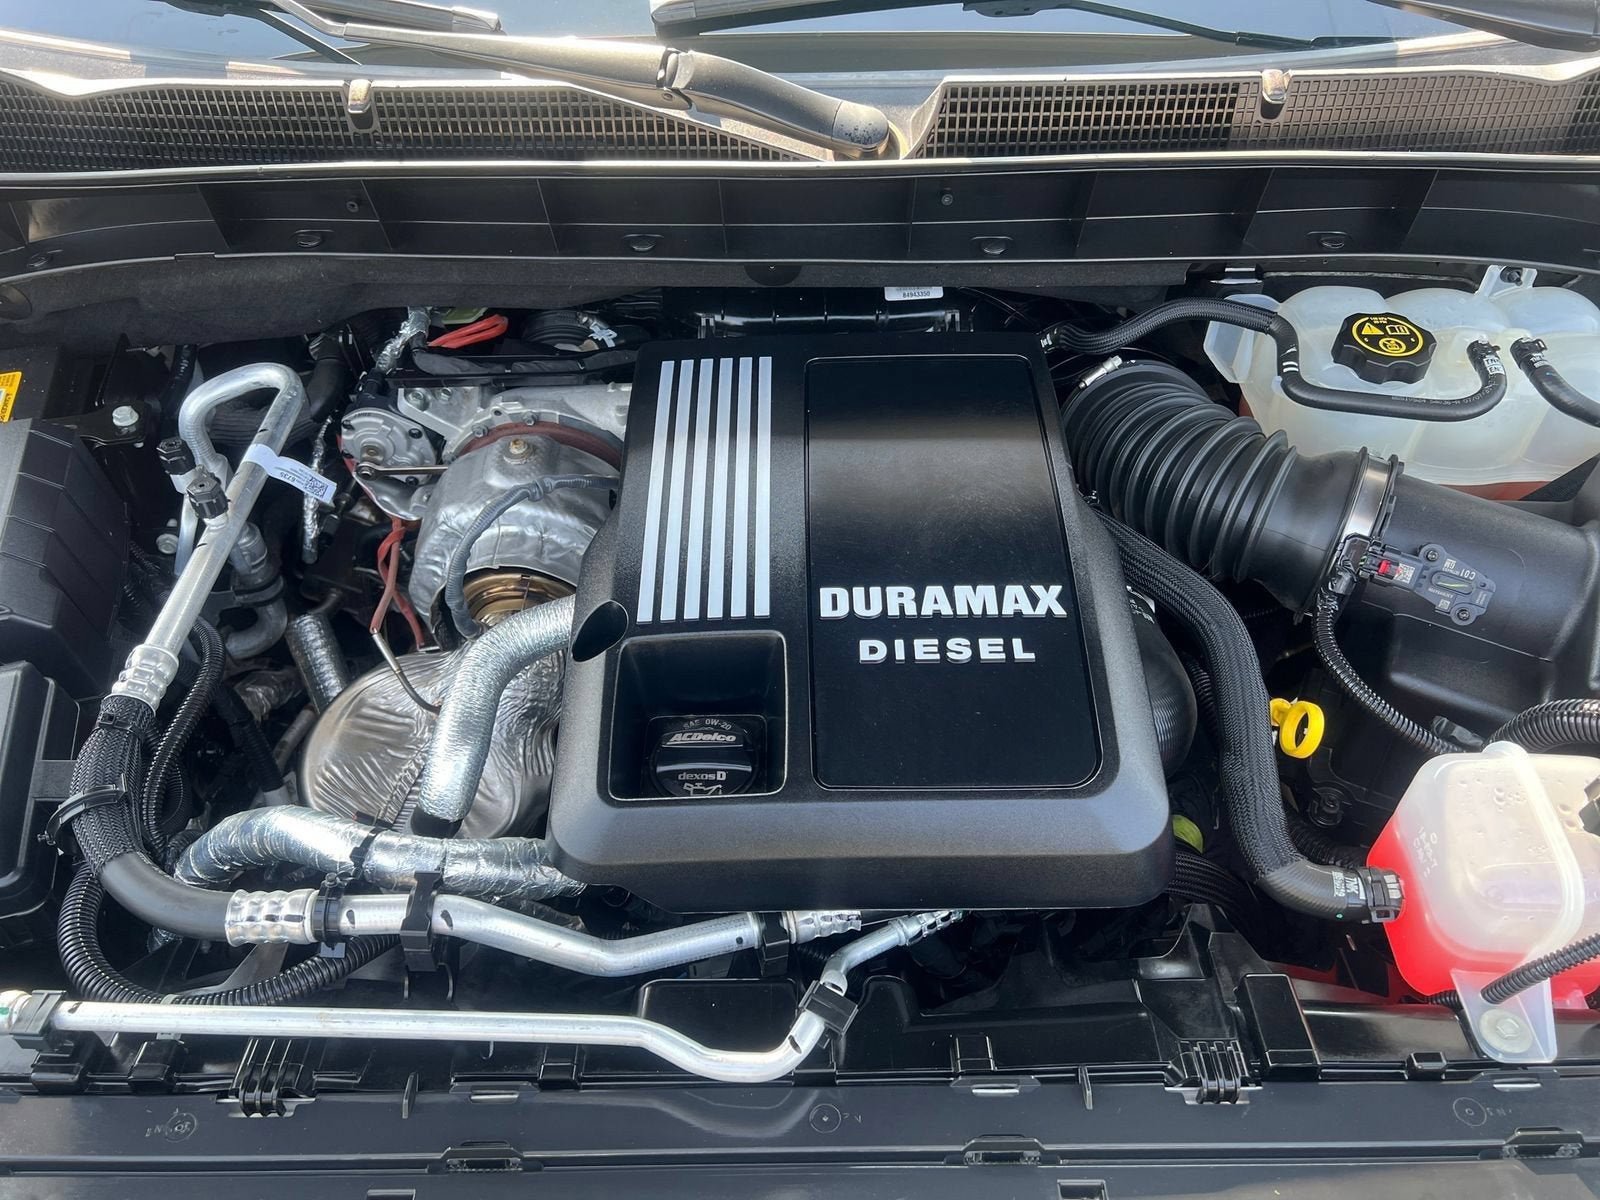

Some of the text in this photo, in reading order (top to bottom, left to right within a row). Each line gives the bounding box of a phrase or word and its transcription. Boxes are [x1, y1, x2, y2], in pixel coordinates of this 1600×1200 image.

[819, 585, 1067, 620] DURAMAX
[859, 638, 1036, 664] DIESEL
[683, 718, 732, 731] SAE 0W-20
[667, 732, 737, 743] ACDelco
